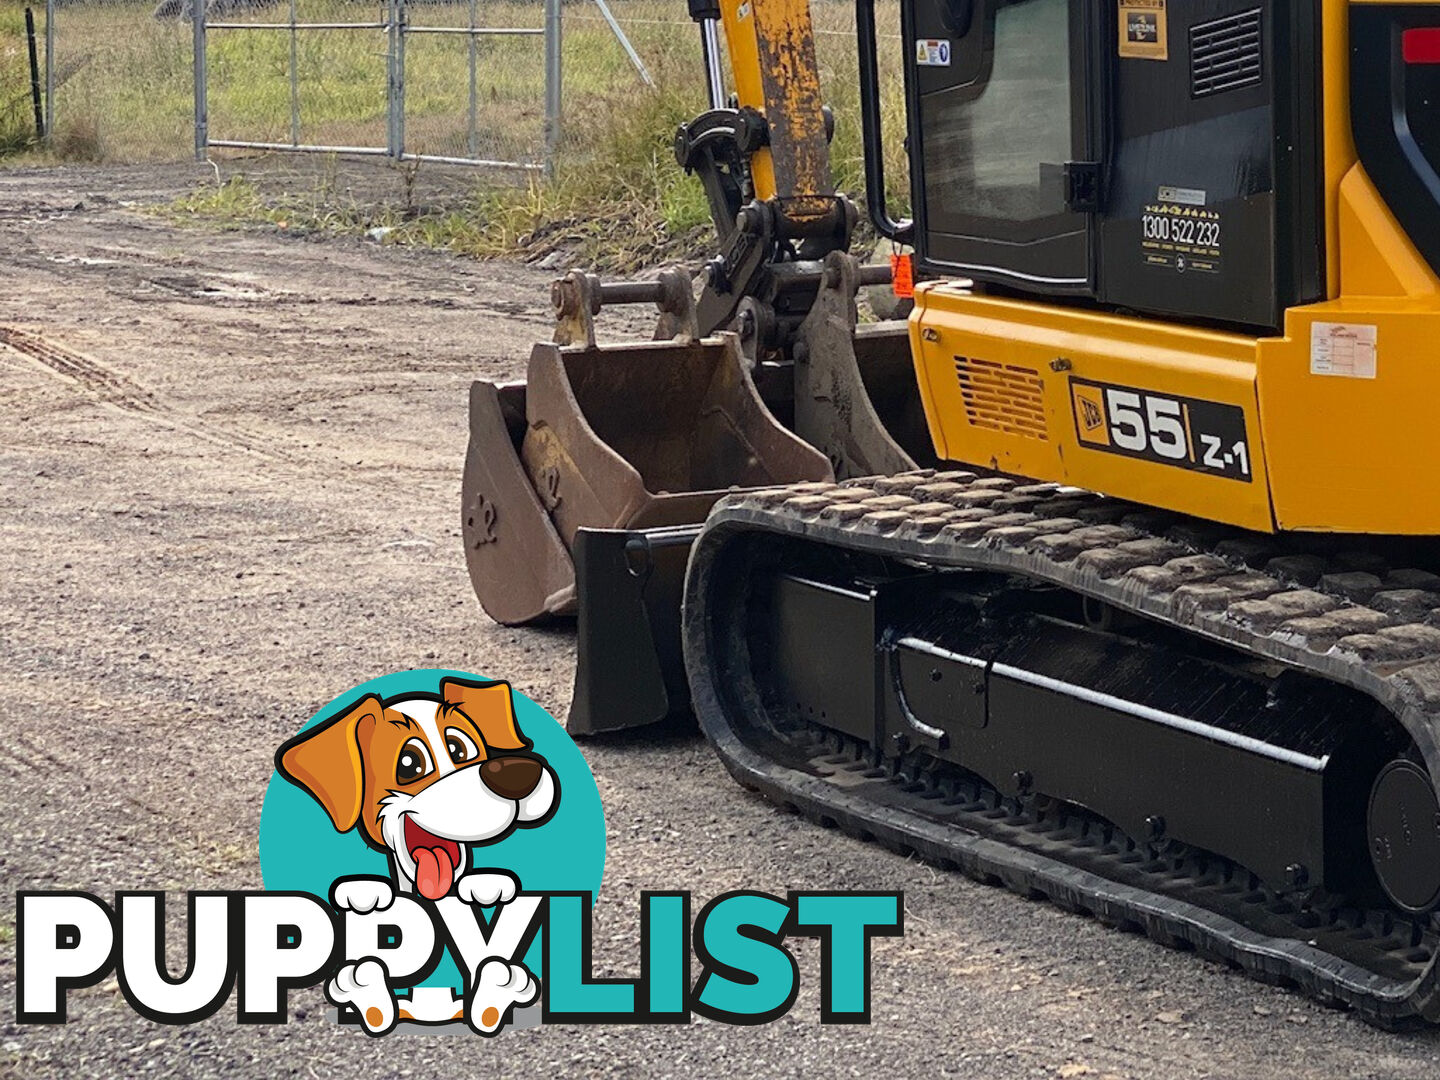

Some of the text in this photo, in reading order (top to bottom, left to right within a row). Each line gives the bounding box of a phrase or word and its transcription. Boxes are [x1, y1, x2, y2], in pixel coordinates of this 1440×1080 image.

[1141, 214, 1220, 247] 1300 522 232
[1106, 388, 1187, 460] 55
[1199, 433, 1249, 475] Z-1
